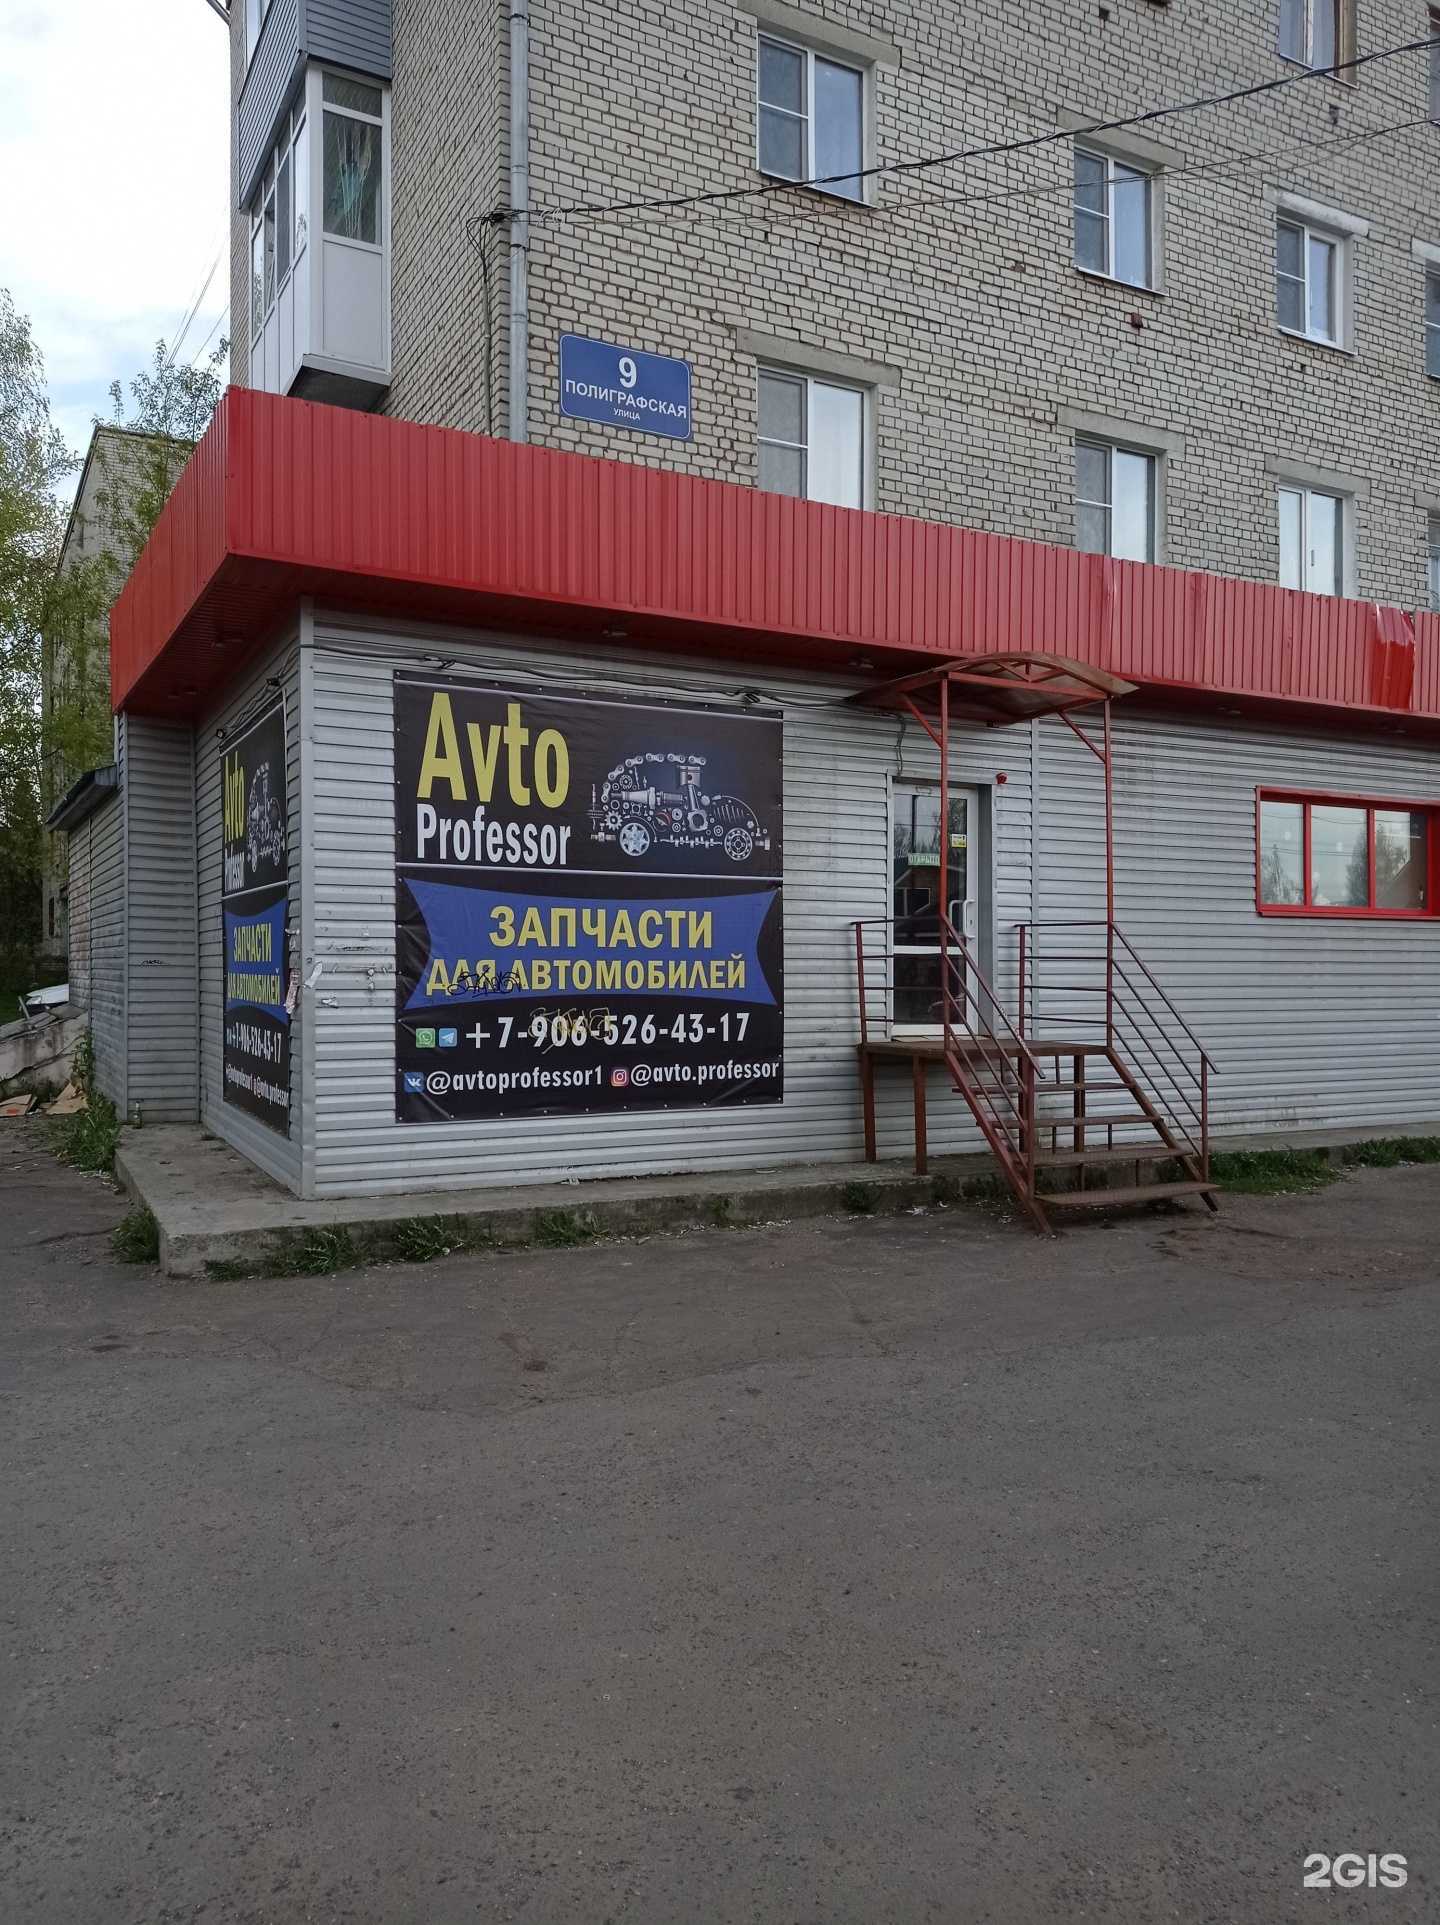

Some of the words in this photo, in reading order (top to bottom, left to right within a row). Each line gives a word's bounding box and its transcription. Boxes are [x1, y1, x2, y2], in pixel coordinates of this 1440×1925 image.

[618, 356, 637, 388] 9
[565, 379, 687, 419] ПОЛИГРАФСКАЯ
[613, 407, 641, 420] УЛИЦА
[416, 692, 570, 808] Avto
[224, 751, 245, 844] Avto
[416, 803, 572, 865] Professor
[233, 922, 272, 963] ЗАПЧАСТИ
[489, 905, 713, 949] ЗАПЧАСТИ
[426, 959, 496, 996] ДЛЯ
[507, 953, 747, 991] АВТОМОБИЛЕЙ
[426, 1065, 603, 1096] @avtoprofessor1
[630, 1060, 780, 1086] @avto.professor
